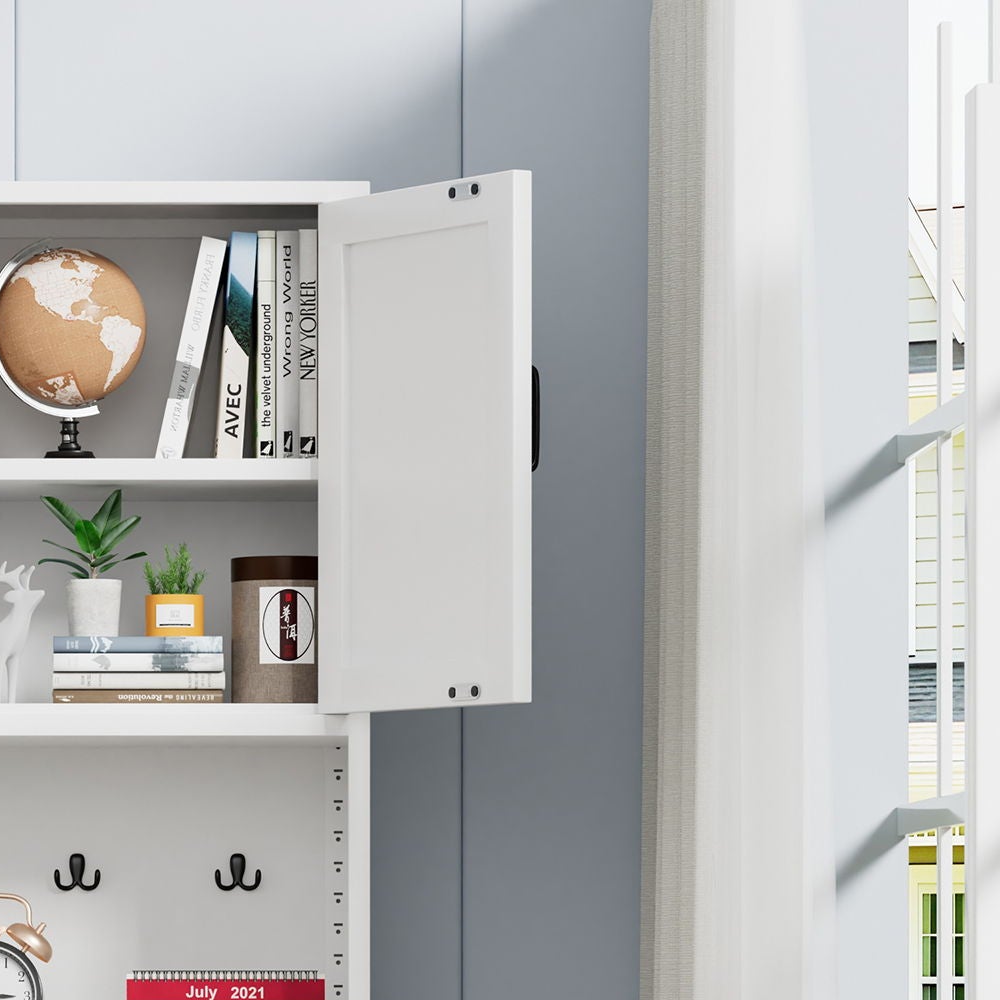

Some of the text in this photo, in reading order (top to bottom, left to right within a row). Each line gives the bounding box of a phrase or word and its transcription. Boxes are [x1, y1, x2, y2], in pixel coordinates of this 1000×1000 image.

[282, 245, 293, 378] Wrong World
[299, 281, 317, 380] NEW YORKER
[261, 304, 273, 427] the velvet underground
[224, 384, 242, 438] AVEC
[118, 694, 162, 702] Revolution
[4, 957, 8, 968] 1
[18, 971, 25, 982] 2
[23, 990, 30, 1000] 3
[185, 985, 264, 1000] July 2021
